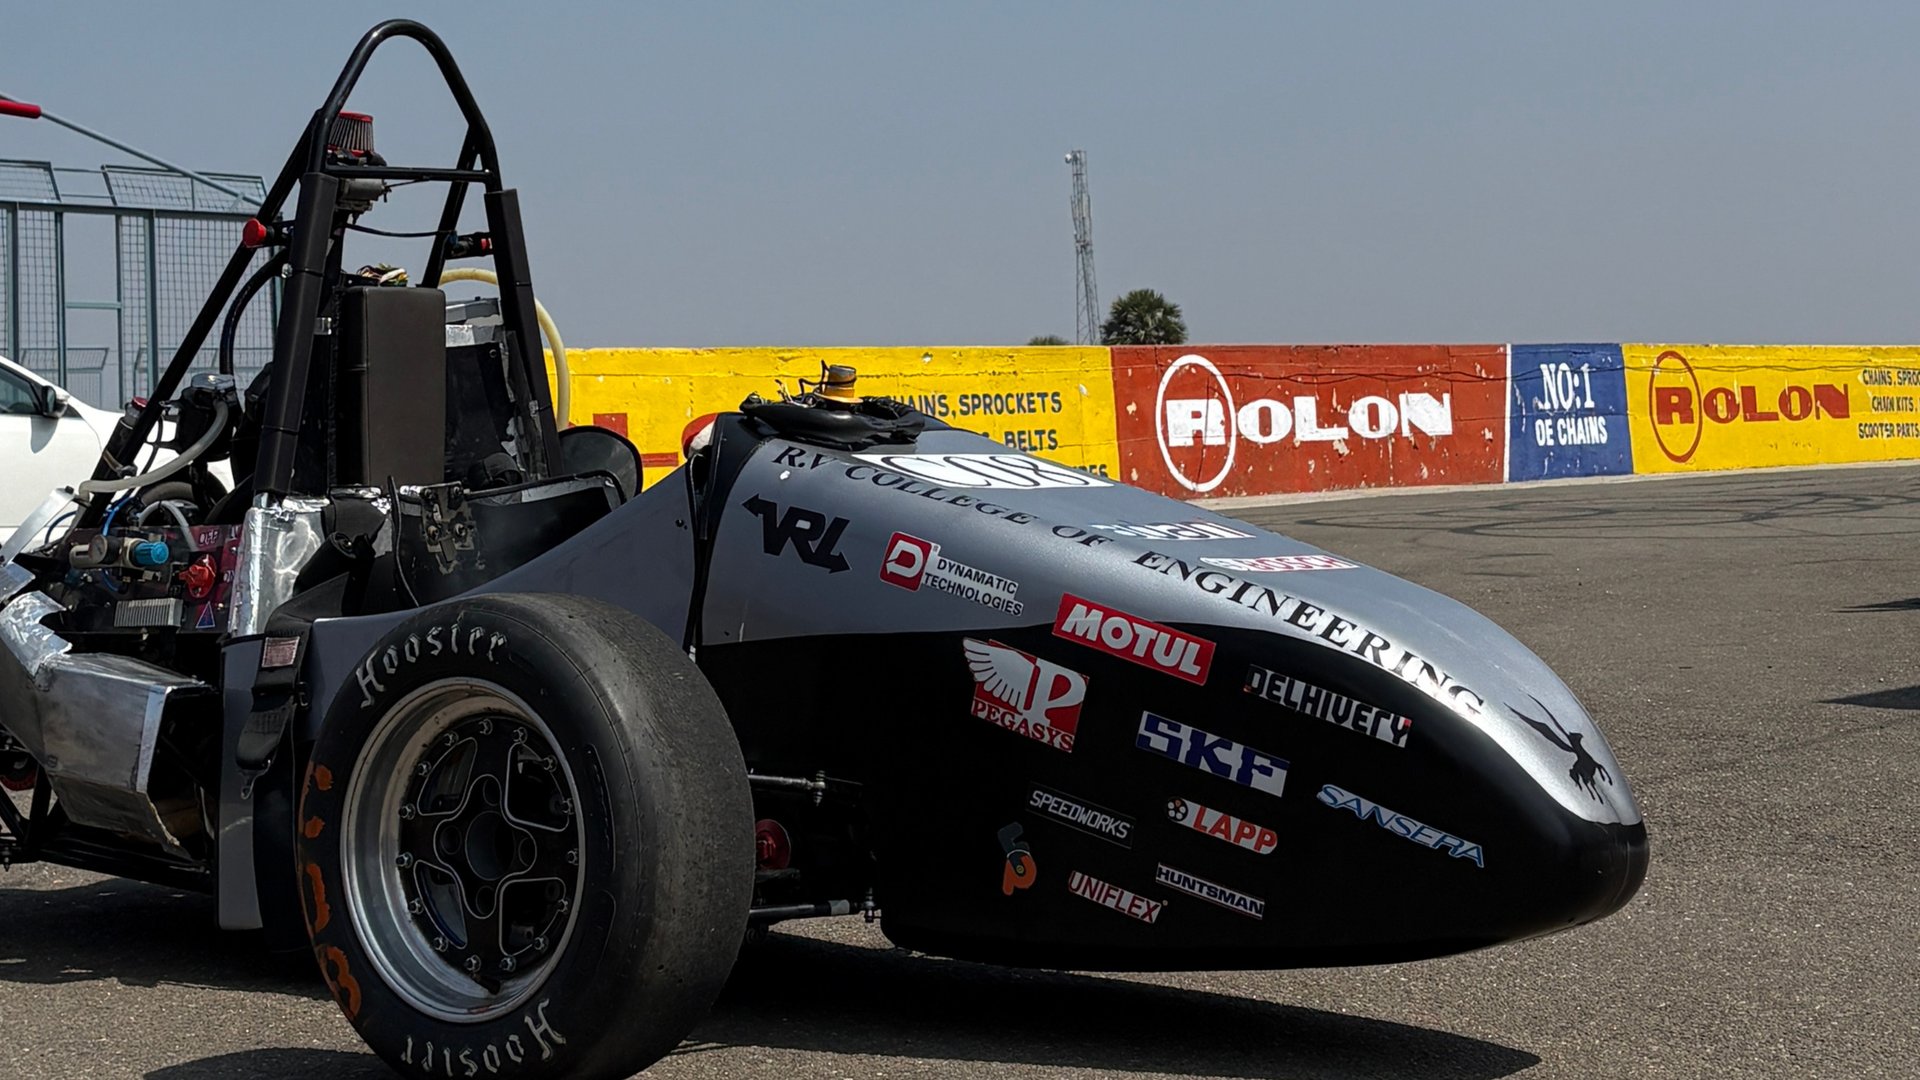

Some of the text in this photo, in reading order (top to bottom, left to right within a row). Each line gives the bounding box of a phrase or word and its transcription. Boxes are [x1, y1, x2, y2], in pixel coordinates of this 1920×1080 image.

[959, 391, 1062, 416] SPROCKETS
[1166, 392, 1453, 447] ROLON
[1655, 383, 1850, 425] ROLON
[1004, 429, 1058, 452] BELTS
[1557, 415, 1608, 446] CHAINS
[741, 494, 852, 574] VRL
[845, 465, 1040, 525] COLLEGE
[1051, 524, 1115, 548] OF
[1131, 551, 1486, 716] ENGINEERING
[924, 572, 1023, 616] TECHNOLOGIES
[937, 558, 1017, 594] DYNAMATIC
[1061, 603, 1202, 676] MOTUL
[972, 700, 1074, 752] PEGASYS
[1248, 665, 1412, 747] DELHIVERY
[1136, 713, 1290, 787] SKF
[1029, 790, 1131, 839] SPEEDWORKS
[1192, 805, 1278, 853] LAPP
[1319, 784, 1484, 867] SANSERA
[1068, 870, 1162, 923] UNIFLEX
[1157, 865, 1264, 915] HUNTSMAN
